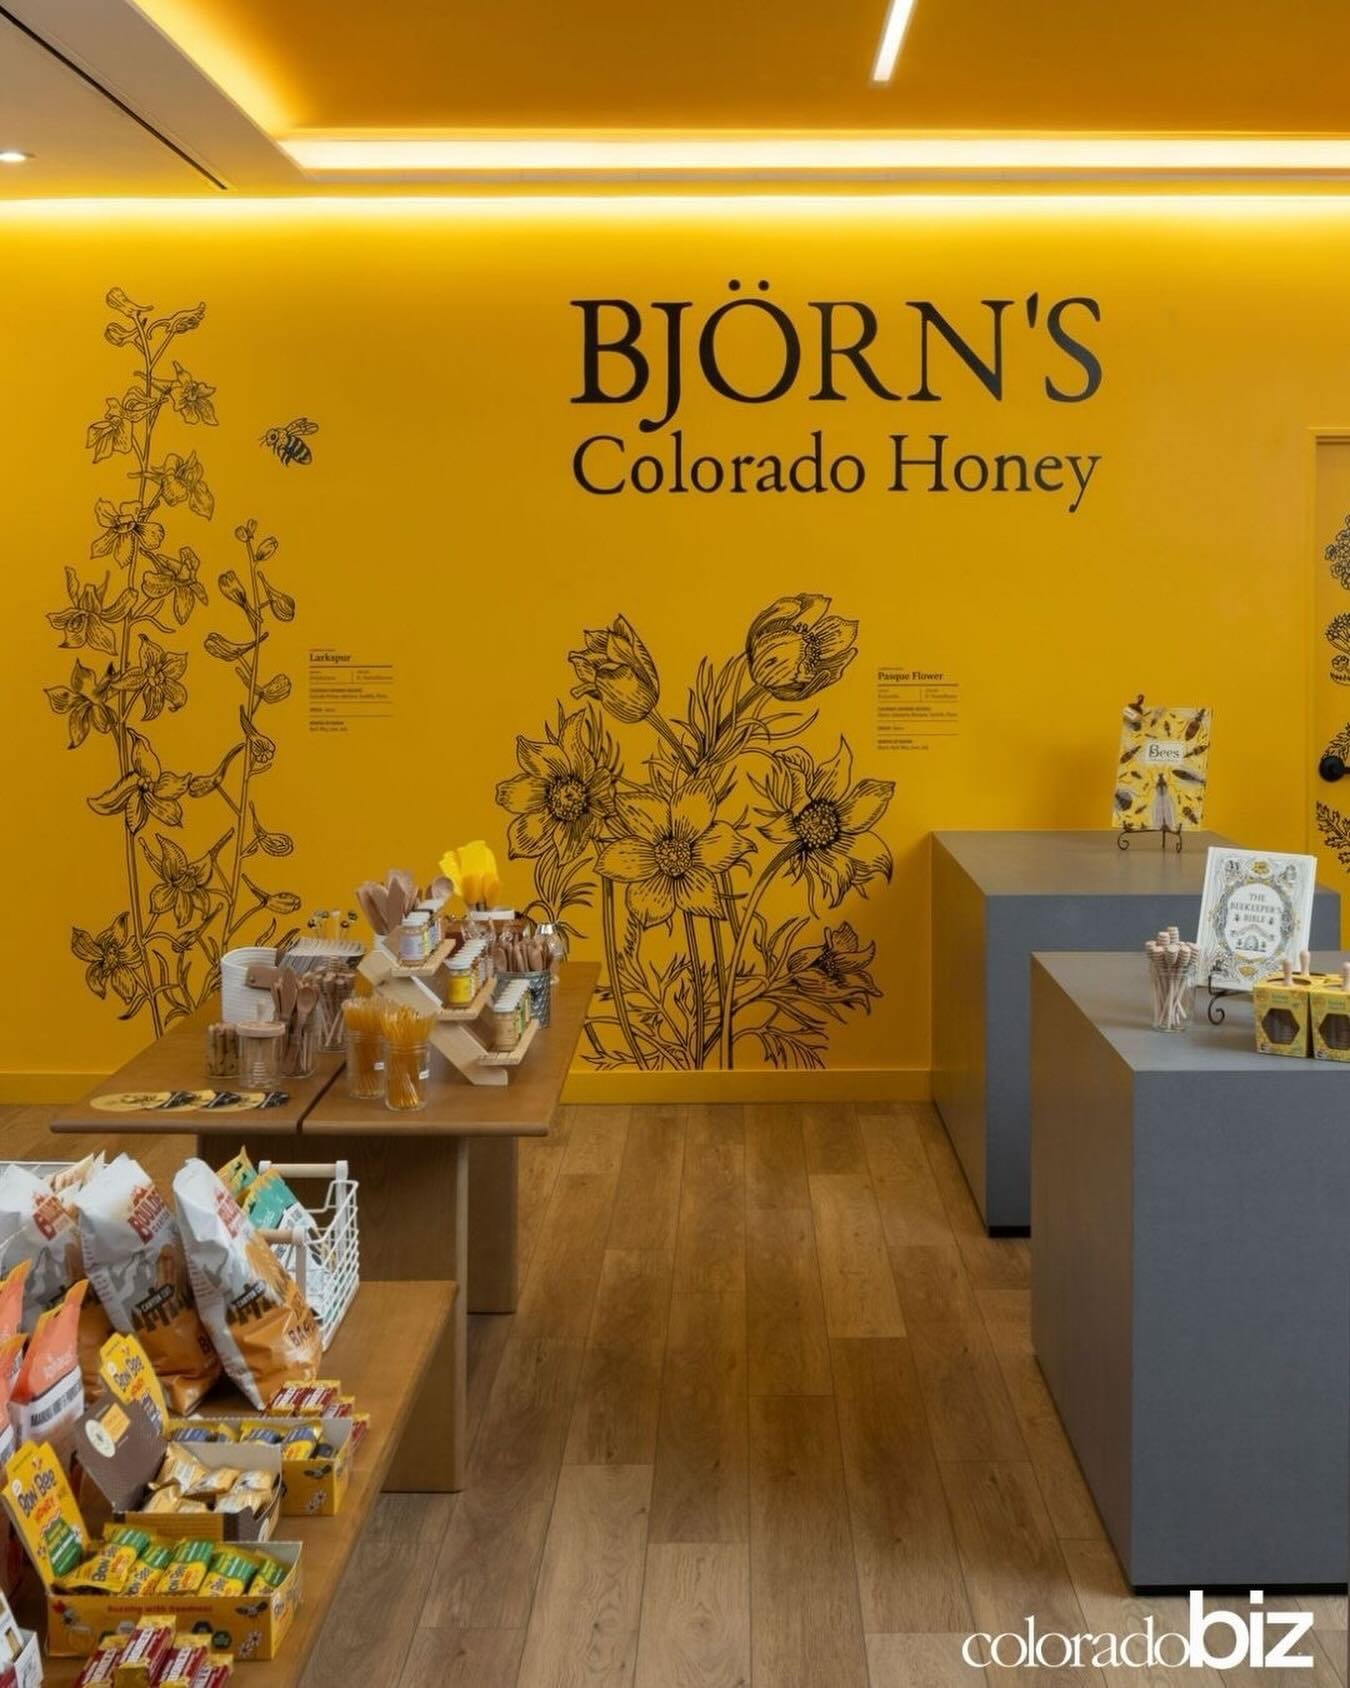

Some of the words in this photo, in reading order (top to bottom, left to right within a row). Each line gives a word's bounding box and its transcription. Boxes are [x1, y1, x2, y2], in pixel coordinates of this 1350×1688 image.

[569, 279, 1103, 433] BJÖRN'S
[572, 430, 866, 495] Colorado
[888, 434, 1103, 513] Honey
[309, 653, 351, 664] Larkspur
[878, 671, 910, 682] Pasque
[912, 671, 944, 681] Flower
[1148, 744, 1179, 759] Bees
[1249, 893, 1265, 902] THE
[1230, 902, 1283, 914] BEEKEEPER'S
[1243, 914, 1266, 924] BIBLE
